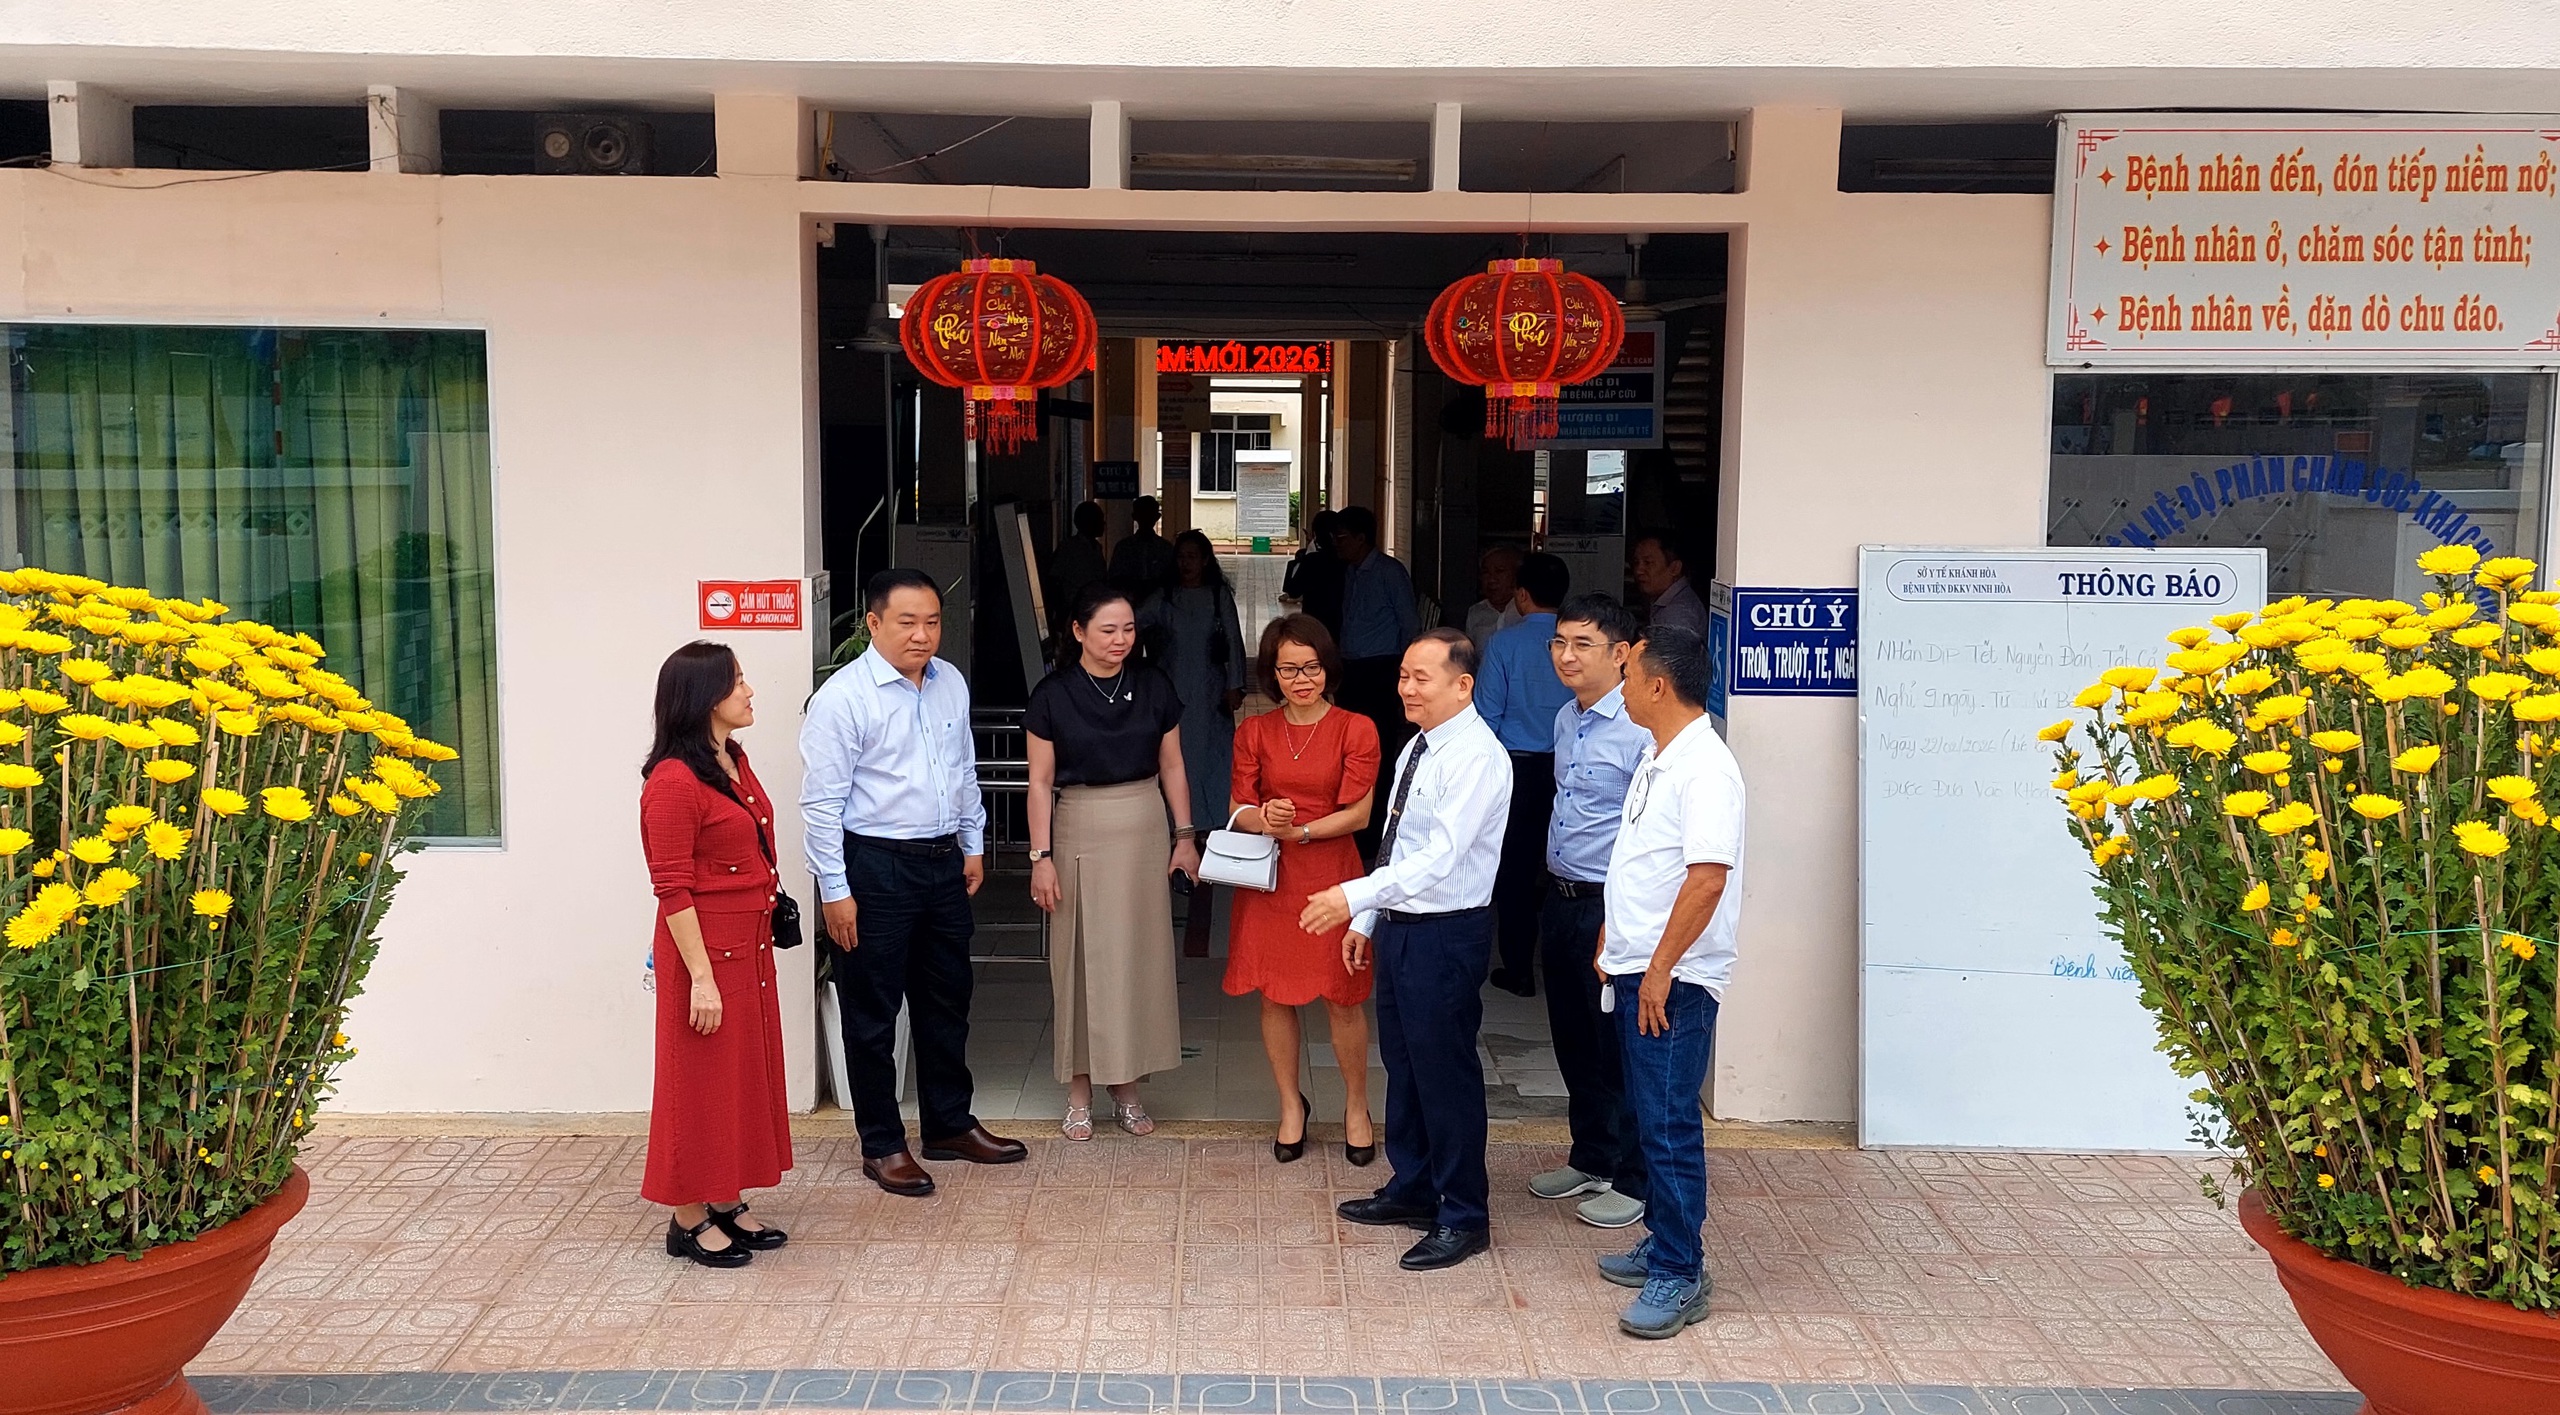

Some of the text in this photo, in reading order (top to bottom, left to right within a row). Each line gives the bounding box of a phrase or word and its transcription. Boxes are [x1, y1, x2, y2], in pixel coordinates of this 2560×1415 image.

[2125, 144, 2557, 202] Bệnh nhân đến, đón tiếp niềm nở;
[2121, 220, 2532, 271] Bệnh nhân ở, chăm sóc tận tình;
[2118, 284, 2504, 341] Bệnh nhân về, dặn dò chu đáo.
[1194, 340, 1246, 370] MỚI
[1253, 345, 1320, 370] 2026
[2140, 491, 2185, 540] HỆ
[2175, 471, 2217, 521] BỘ
[2214, 451, 2286, 505] PHẬN
[1929, 568, 1936, 578] Y
[1936, 565, 1948, 578] TẾ
[1949, 566, 1978, 579] KHÁNH
[1979, 566, 1997, 579] HÒA
[2058, 567, 2221, 598] THÔNG BÁO
[739, 586, 755, 609] CẤM
[756, 588, 770, 610] HÚT
[771, 586, 795, 610] THUỐC
[1903, 581, 1925, 595] BỆNH
[1926, 581, 1947, 595] VIỆN
[1972, 584, 1993, 594] NINH
[1994, 581, 2012, 594] HÒA
[740, 613, 795, 624] NO SMOKING
[1750, 597, 1817, 627] CHÚ
[1826, 597, 1849, 627] Ý
[1774, 640, 1812, 686] TRƯỢT,
[1814, 638, 1832, 685] TÉ,
[1834, 639, 1856, 680] NGÃ
[2050, 953, 2098, 980] Bệnh
